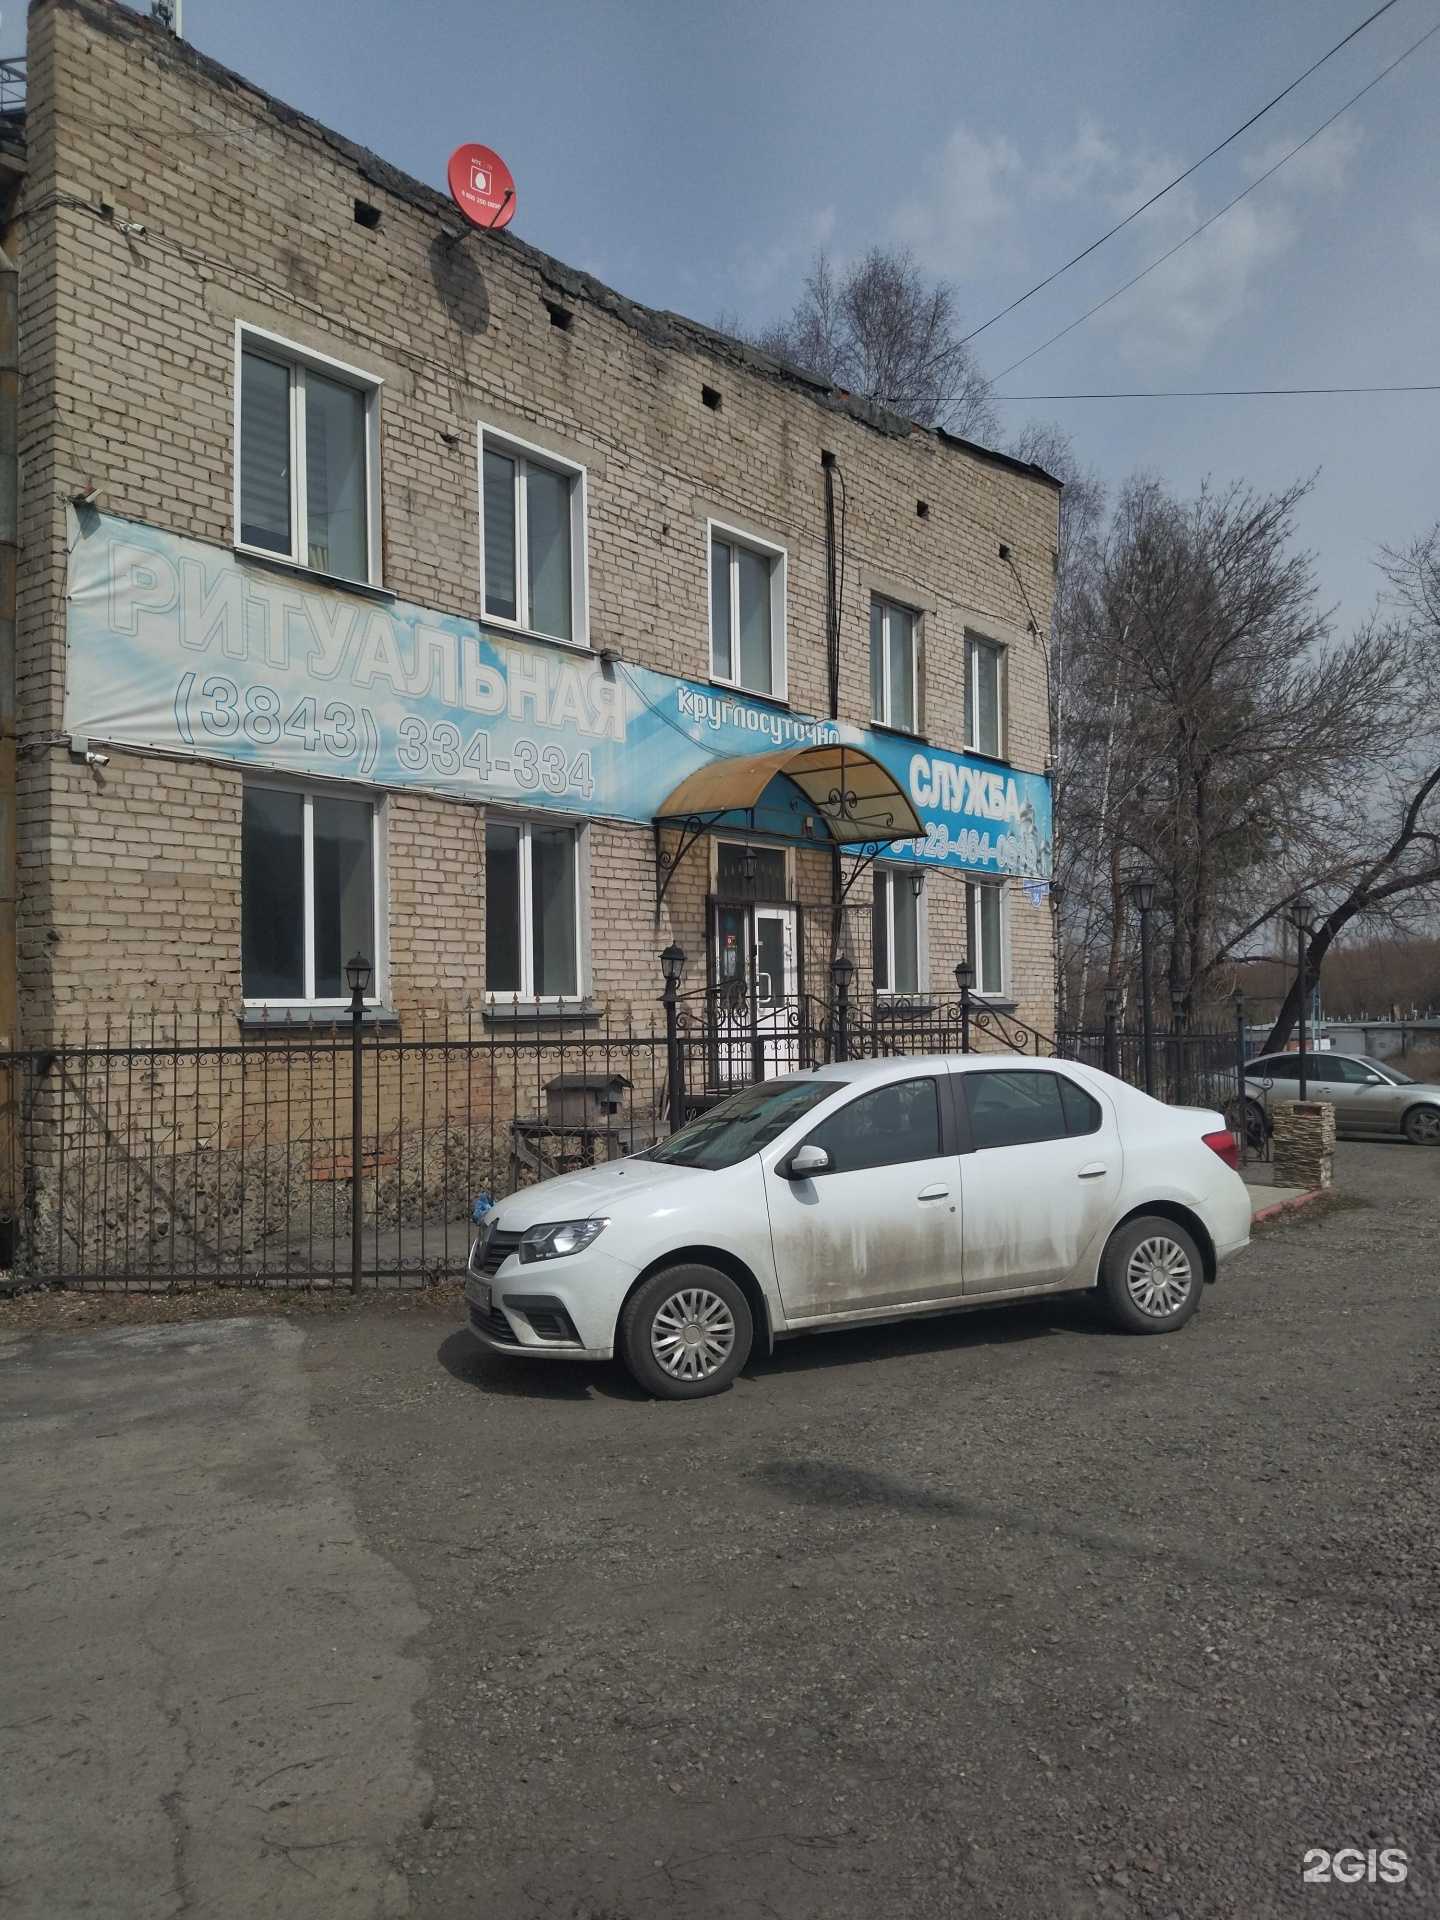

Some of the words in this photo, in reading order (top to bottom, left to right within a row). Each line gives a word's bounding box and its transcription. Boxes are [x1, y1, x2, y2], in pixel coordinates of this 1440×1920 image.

[108, 539, 626, 743] РИТУАЛЬНАЯ
[174, 671, 378, 774] (3843)
[398, 716, 595, 799] 334-334
[909, 753, 1021, 825] СЛУЖБА
